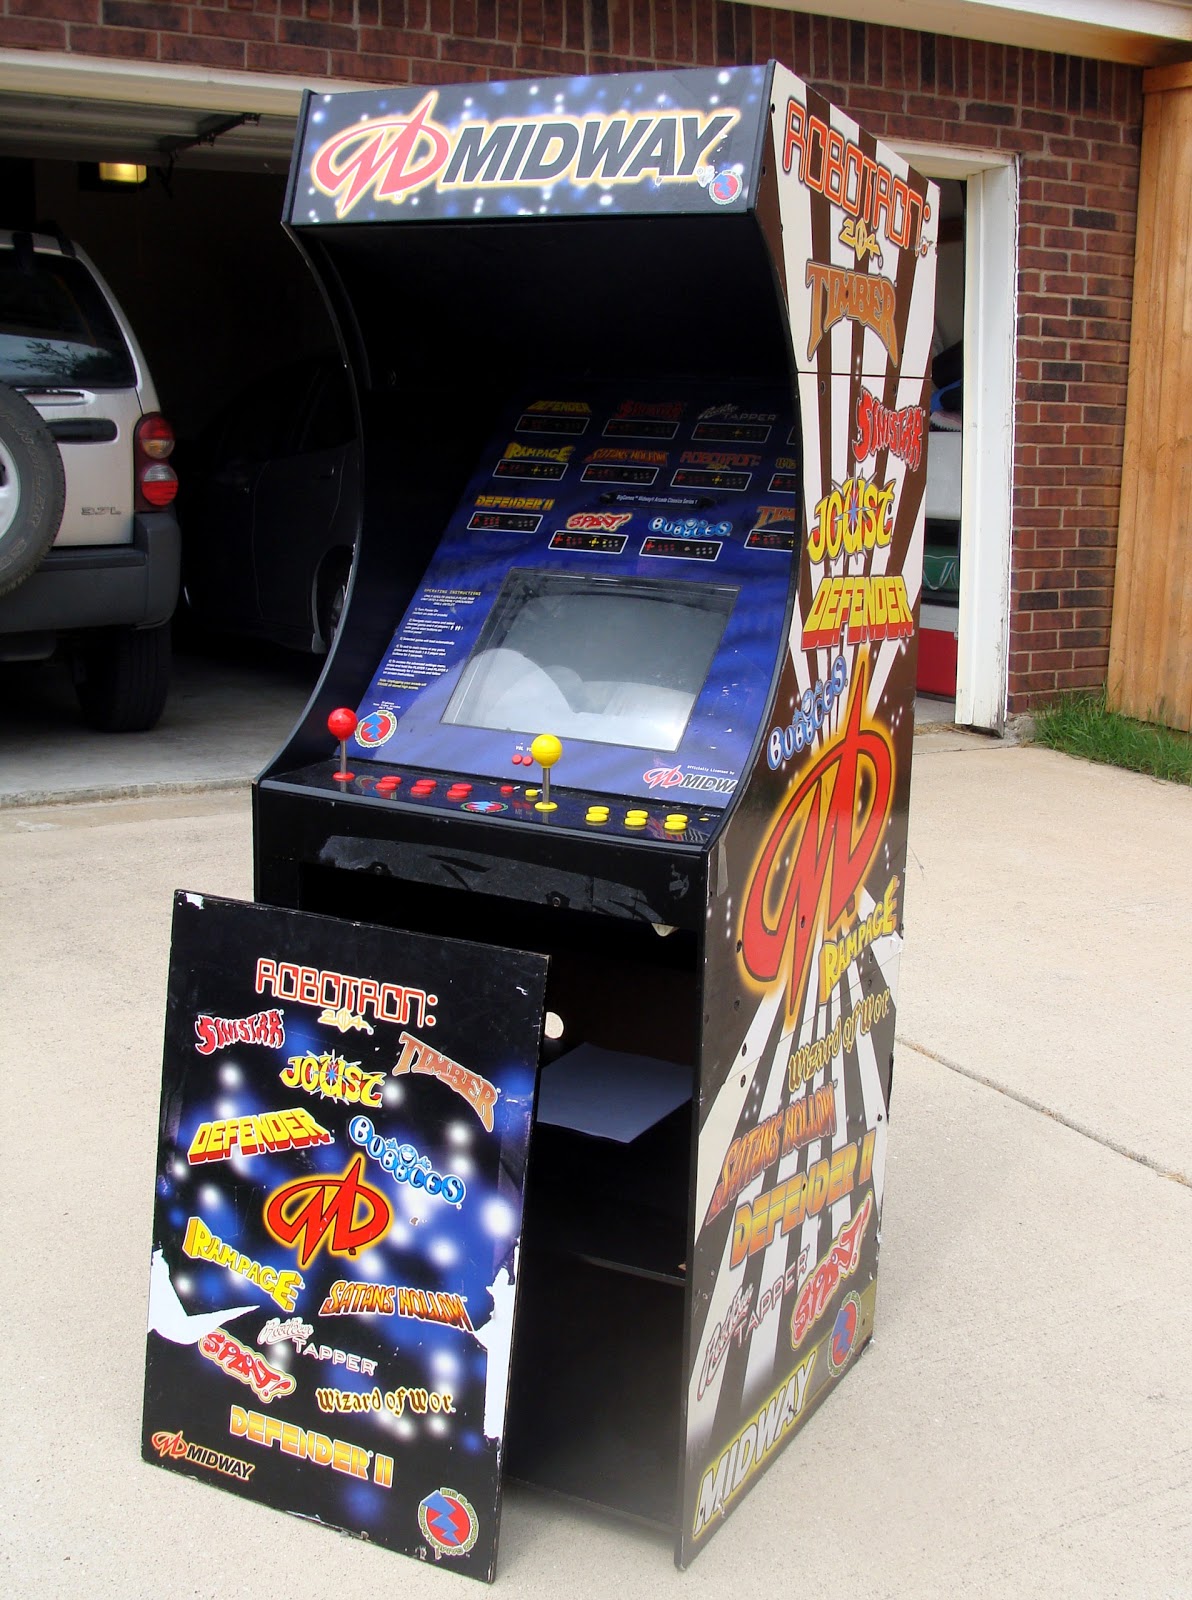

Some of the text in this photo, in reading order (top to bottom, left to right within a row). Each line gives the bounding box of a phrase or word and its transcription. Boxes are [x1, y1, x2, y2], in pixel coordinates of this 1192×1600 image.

[440, 113, 737, 184] MIDWAY
[806, 259, 898, 368] TIMBER
[504, 442, 575, 462] RAMPAGE
[852, 386, 923, 472] SINISTAR
[475, 495, 544, 510] DEFENDER
[648, 516, 732, 538] BUBBLES
[807, 474, 896, 565] JOUST
[801, 575, 914, 650] DEFENDER
[767, 655, 847, 770] BUBBLES
[819, 875, 899, 1005] RAMPAGE
[195, 1009, 283, 1054] SINISTAR
[788, 1015, 842, 1092] Wizard
[842, 1000, 861, 1053] of
[279, 1052, 386, 1107] JOUST
[392, 1031, 498, 1132] TIMBER
[782, 1081, 837, 1157] HOLLOW
[188, 1107, 333, 1165] DEFENDER
[349, 1115, 466, 1205] BUBBLES
[730, 1129, 876, 1270] DEFENDER II
[182, 1217, 303, 1312] RAMPAGE
[734, 1250, 808, 1347] TAPPER
[319, 1280, 474, 1332] SATANS HOLLOW
[292, 1337, 377, 1376] TAPPER
[316, 1386, 383, 1413] Wizard
[384, 1387, 407, 1417] of
[186, 1443, 255, 1480] MIDWAY
[230, 1404, 396, 1488] DEFENDER II
[694, 1351, 816, 1537] MIDWAY
